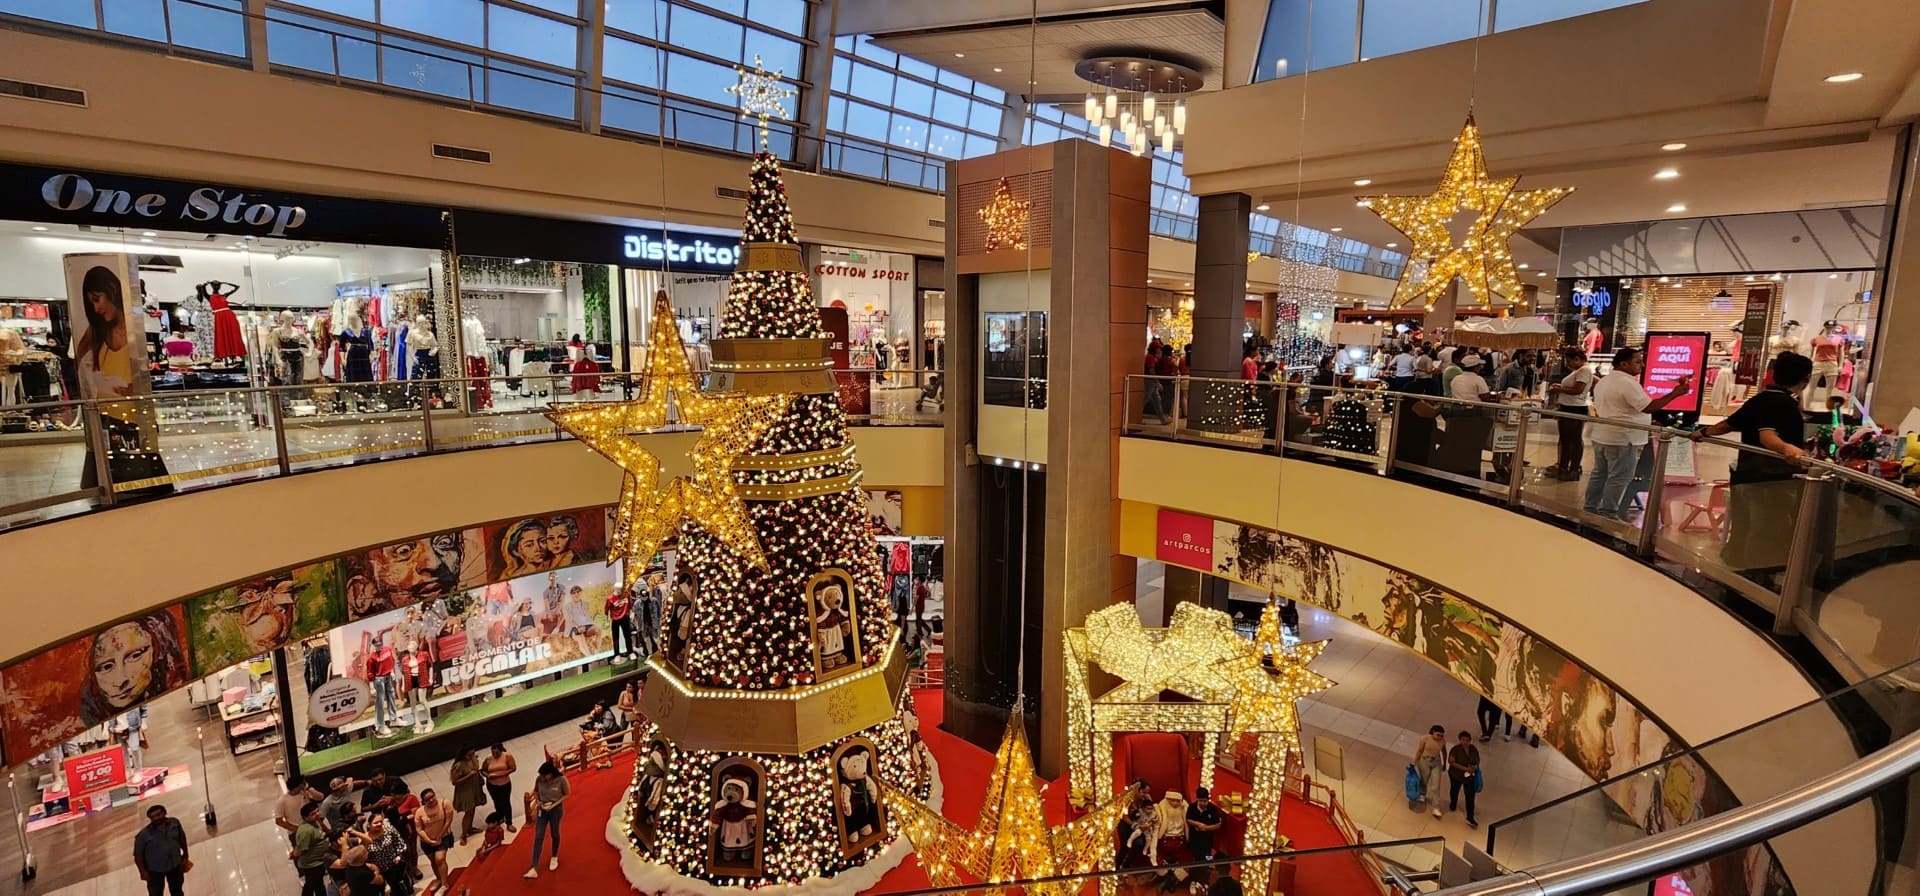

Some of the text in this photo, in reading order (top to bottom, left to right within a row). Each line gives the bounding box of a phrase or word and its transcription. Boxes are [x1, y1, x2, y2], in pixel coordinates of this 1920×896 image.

[41, 173, 308, 237] One Stop
[815, 264, 910, 282] COTTON SPORT
[1163, 539, 1211, 555] artparcos
[451, 637, 541, 666] ES MOMENTO DE
[324, 697, 356, 713] $1.00
[80, 765, 112, 781] $1.00
